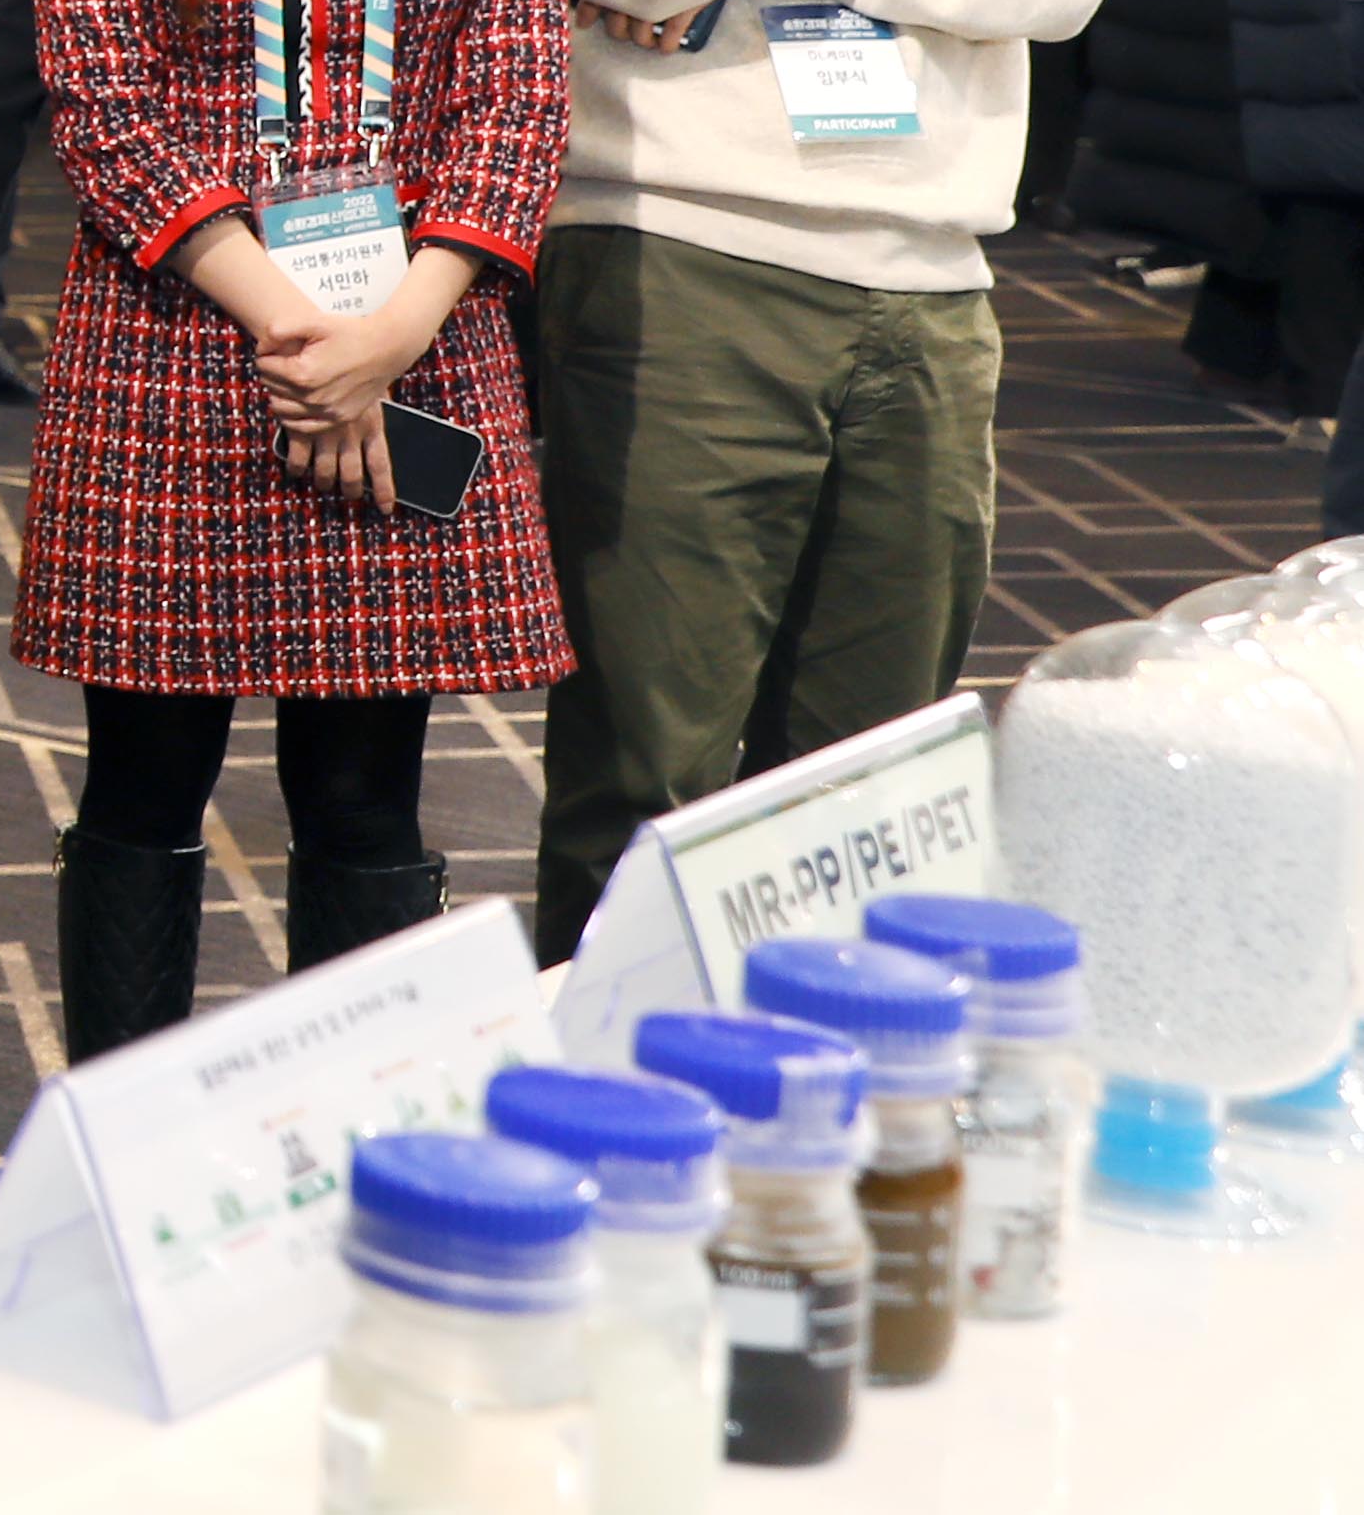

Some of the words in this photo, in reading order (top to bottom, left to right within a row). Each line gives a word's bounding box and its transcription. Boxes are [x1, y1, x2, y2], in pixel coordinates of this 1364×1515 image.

[813, 117, 897, 131] PARTICIPANT
[343, 193, 376, 209] 2022
[291, 241, 384, 271] 산업통상자원부
[318, 268, 370, 293] 서민하
[718, 785, 977, 951] MR-PP/PE/PET
